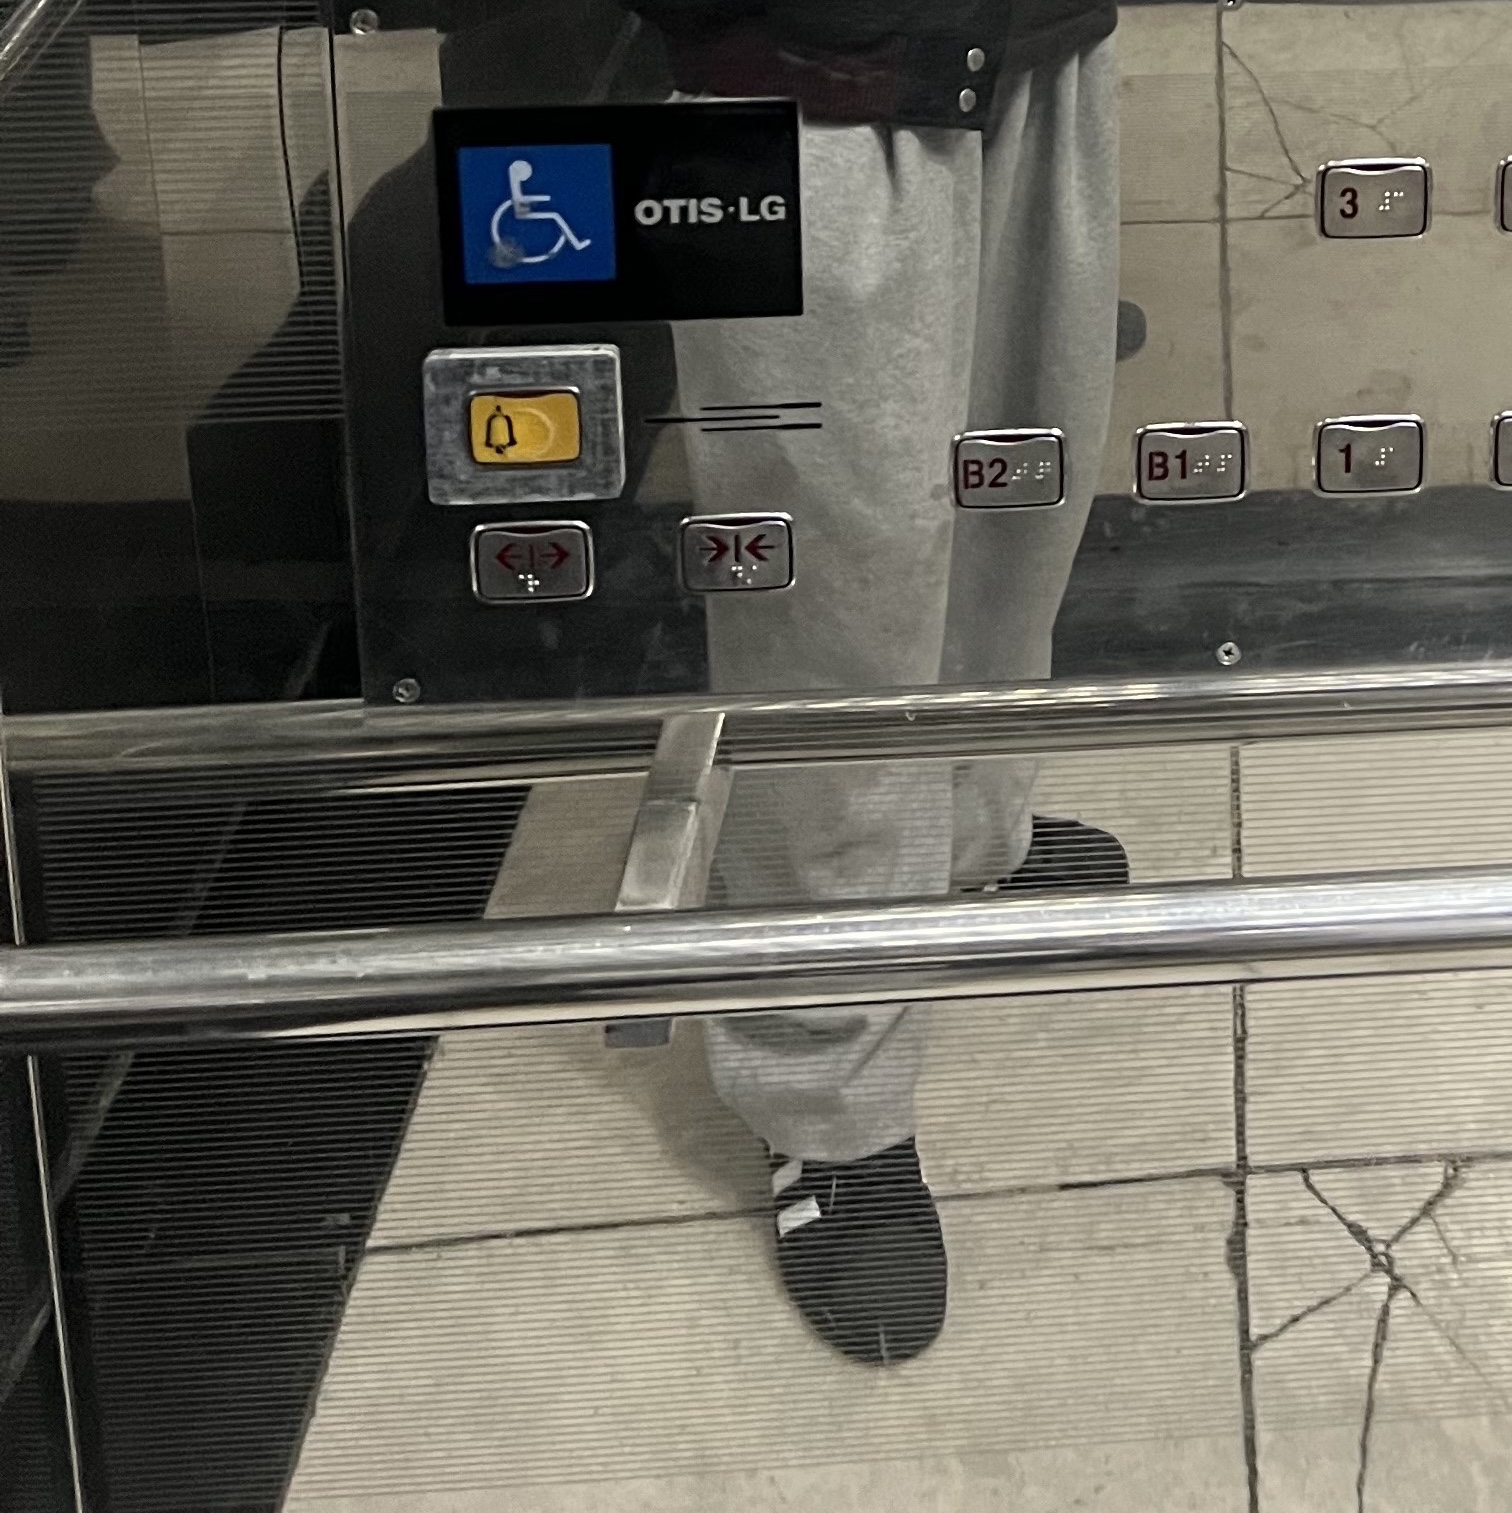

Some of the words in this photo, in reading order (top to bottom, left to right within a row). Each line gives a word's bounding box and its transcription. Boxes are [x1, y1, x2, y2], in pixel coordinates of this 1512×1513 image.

[1339, 189, 1359, 219] 3
[962, 457, 1009, 490] B2
[1149, 449, 1189, 482] B1
[1338, 443, 1351, 474] 1
